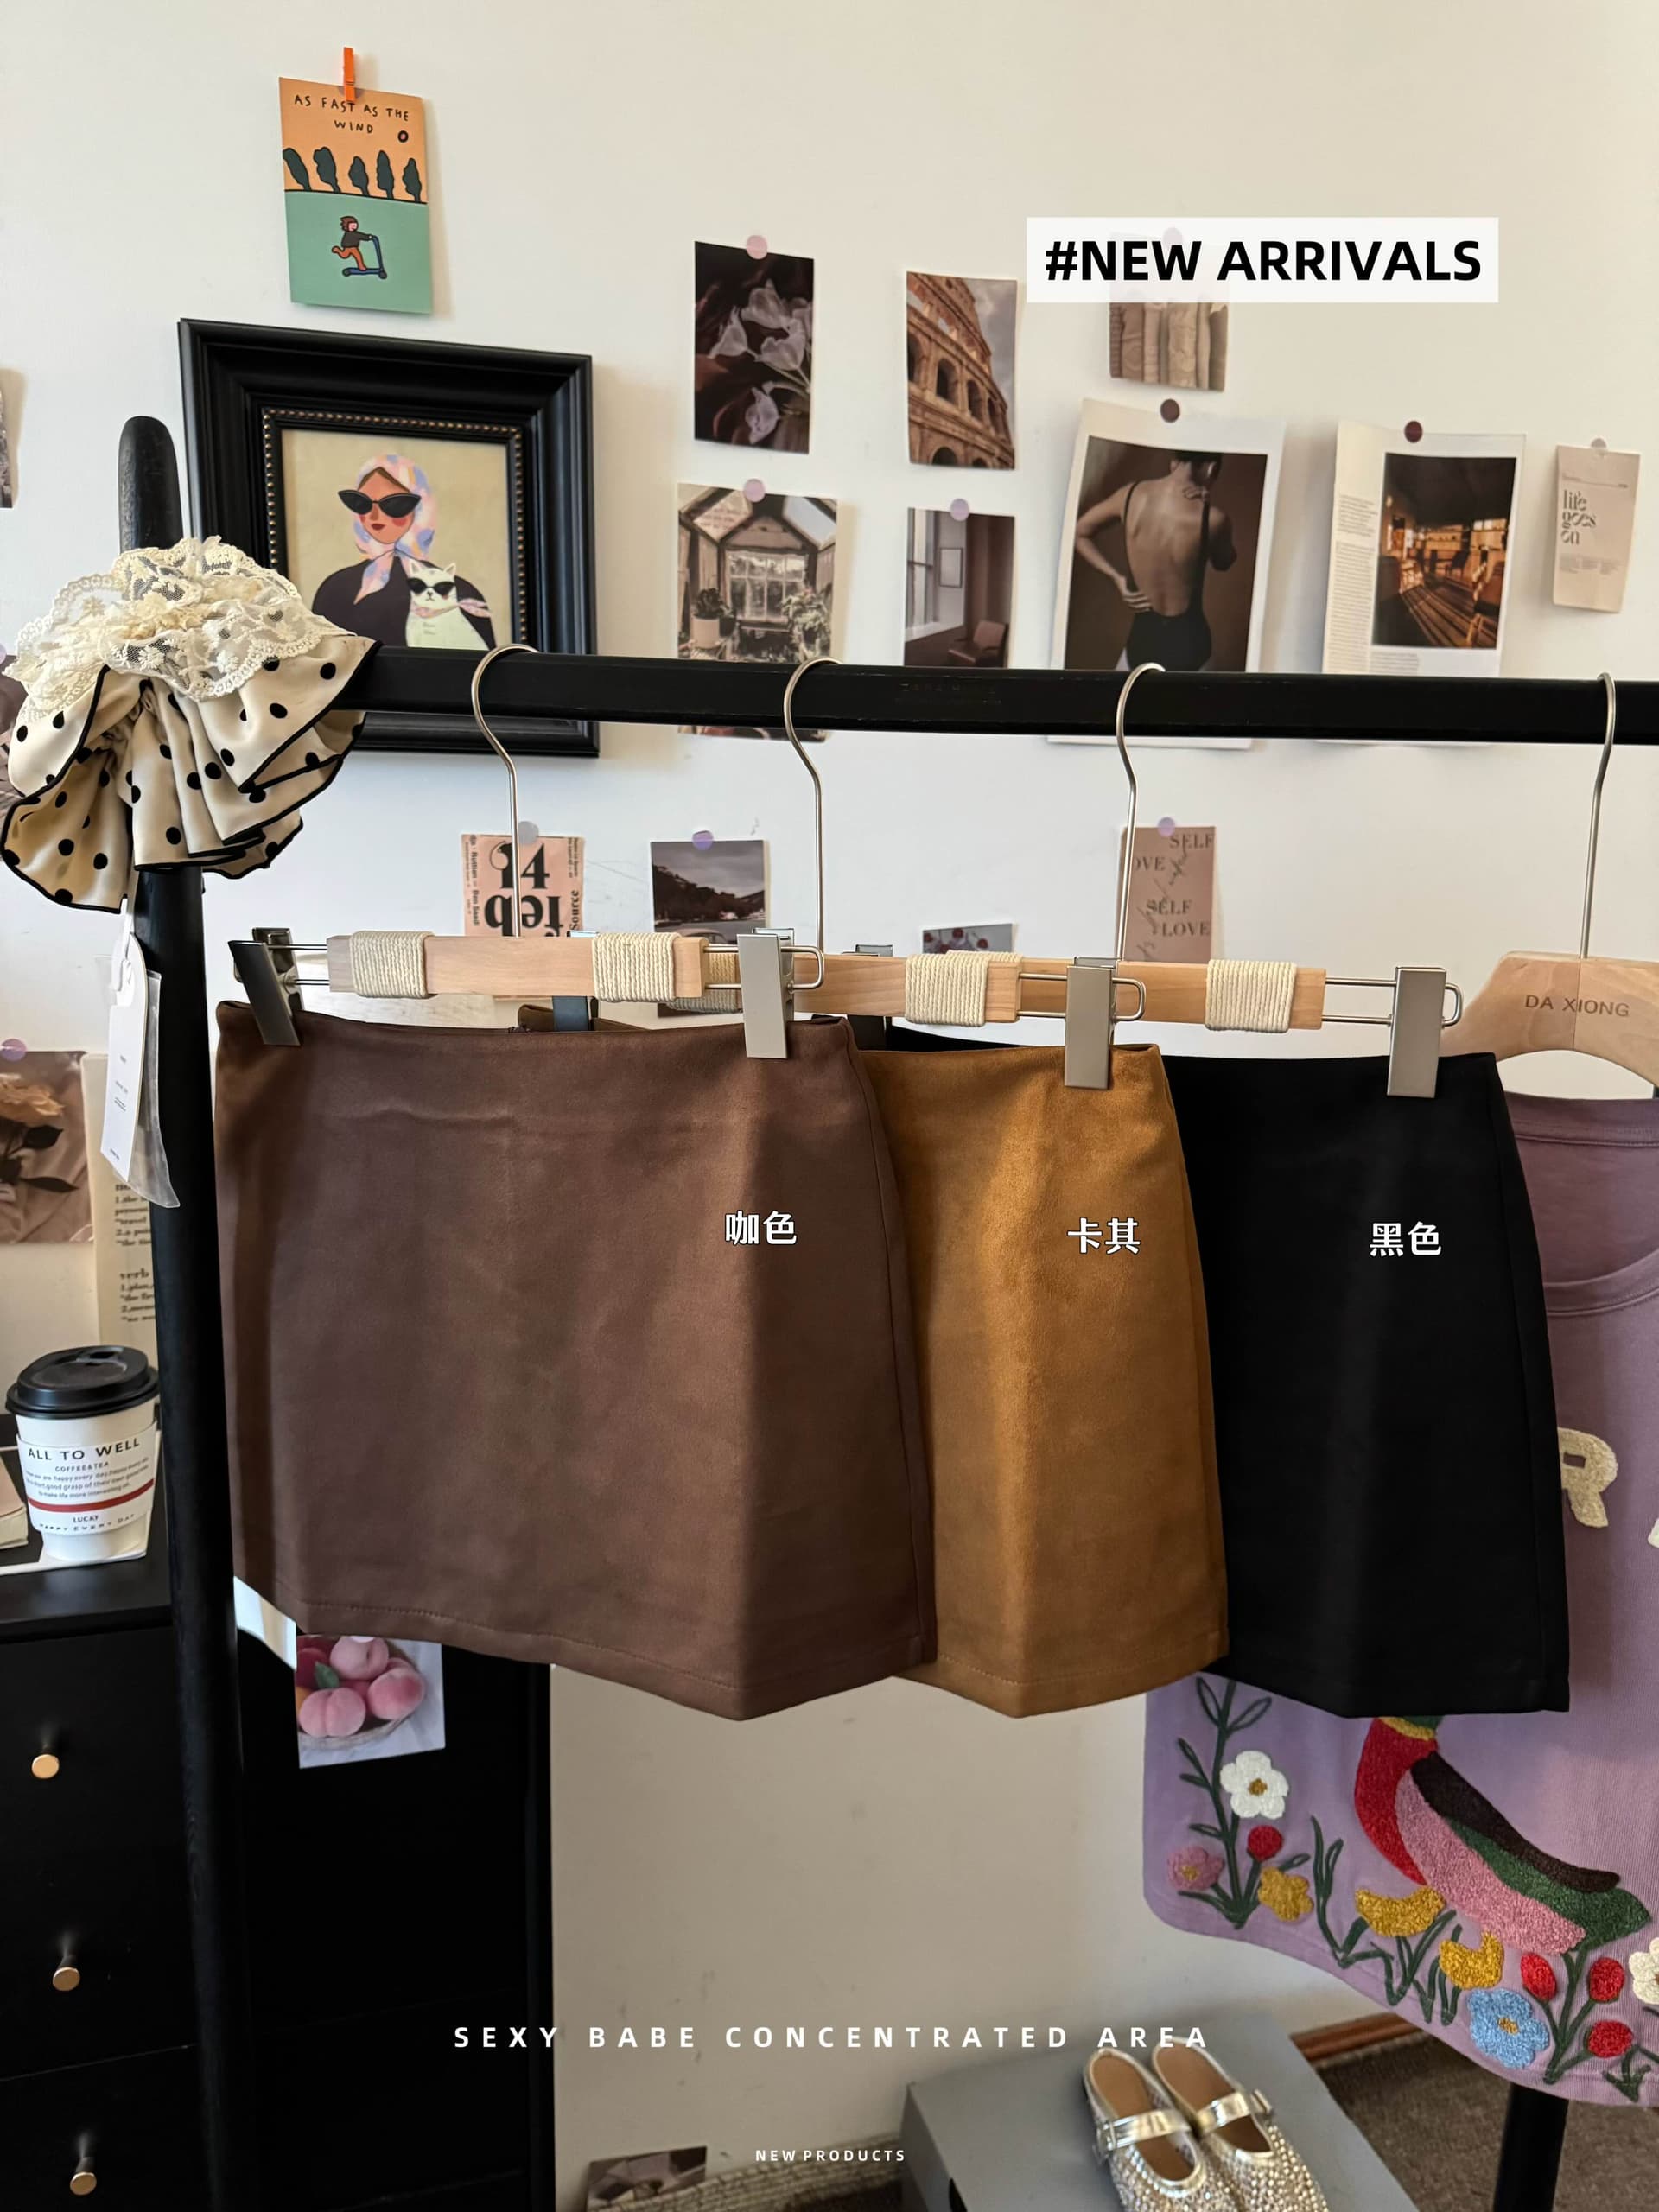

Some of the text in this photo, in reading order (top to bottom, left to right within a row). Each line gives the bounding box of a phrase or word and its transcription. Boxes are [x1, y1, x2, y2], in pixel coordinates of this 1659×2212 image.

[295, 94, 409, 121] AS FAST AS THE
[334, 120, 373, 133] WIND
[1563, 489, 1587, 511] life
[1560, 530, 1580, 545] on
[1169, 833, 1214, 849] SELF
[1146, 899, 1192, 916] SELF
[1161, 921, 1211, 937] LOVE
[1525, 995, 1630, 1017] DA XIONG
[29, 1438, 140, 1461] ALL TO WELL
[54, 1461, 110, 1472] COFFEE&TEA
[73, 1515, 99, 1523] LUCKY
